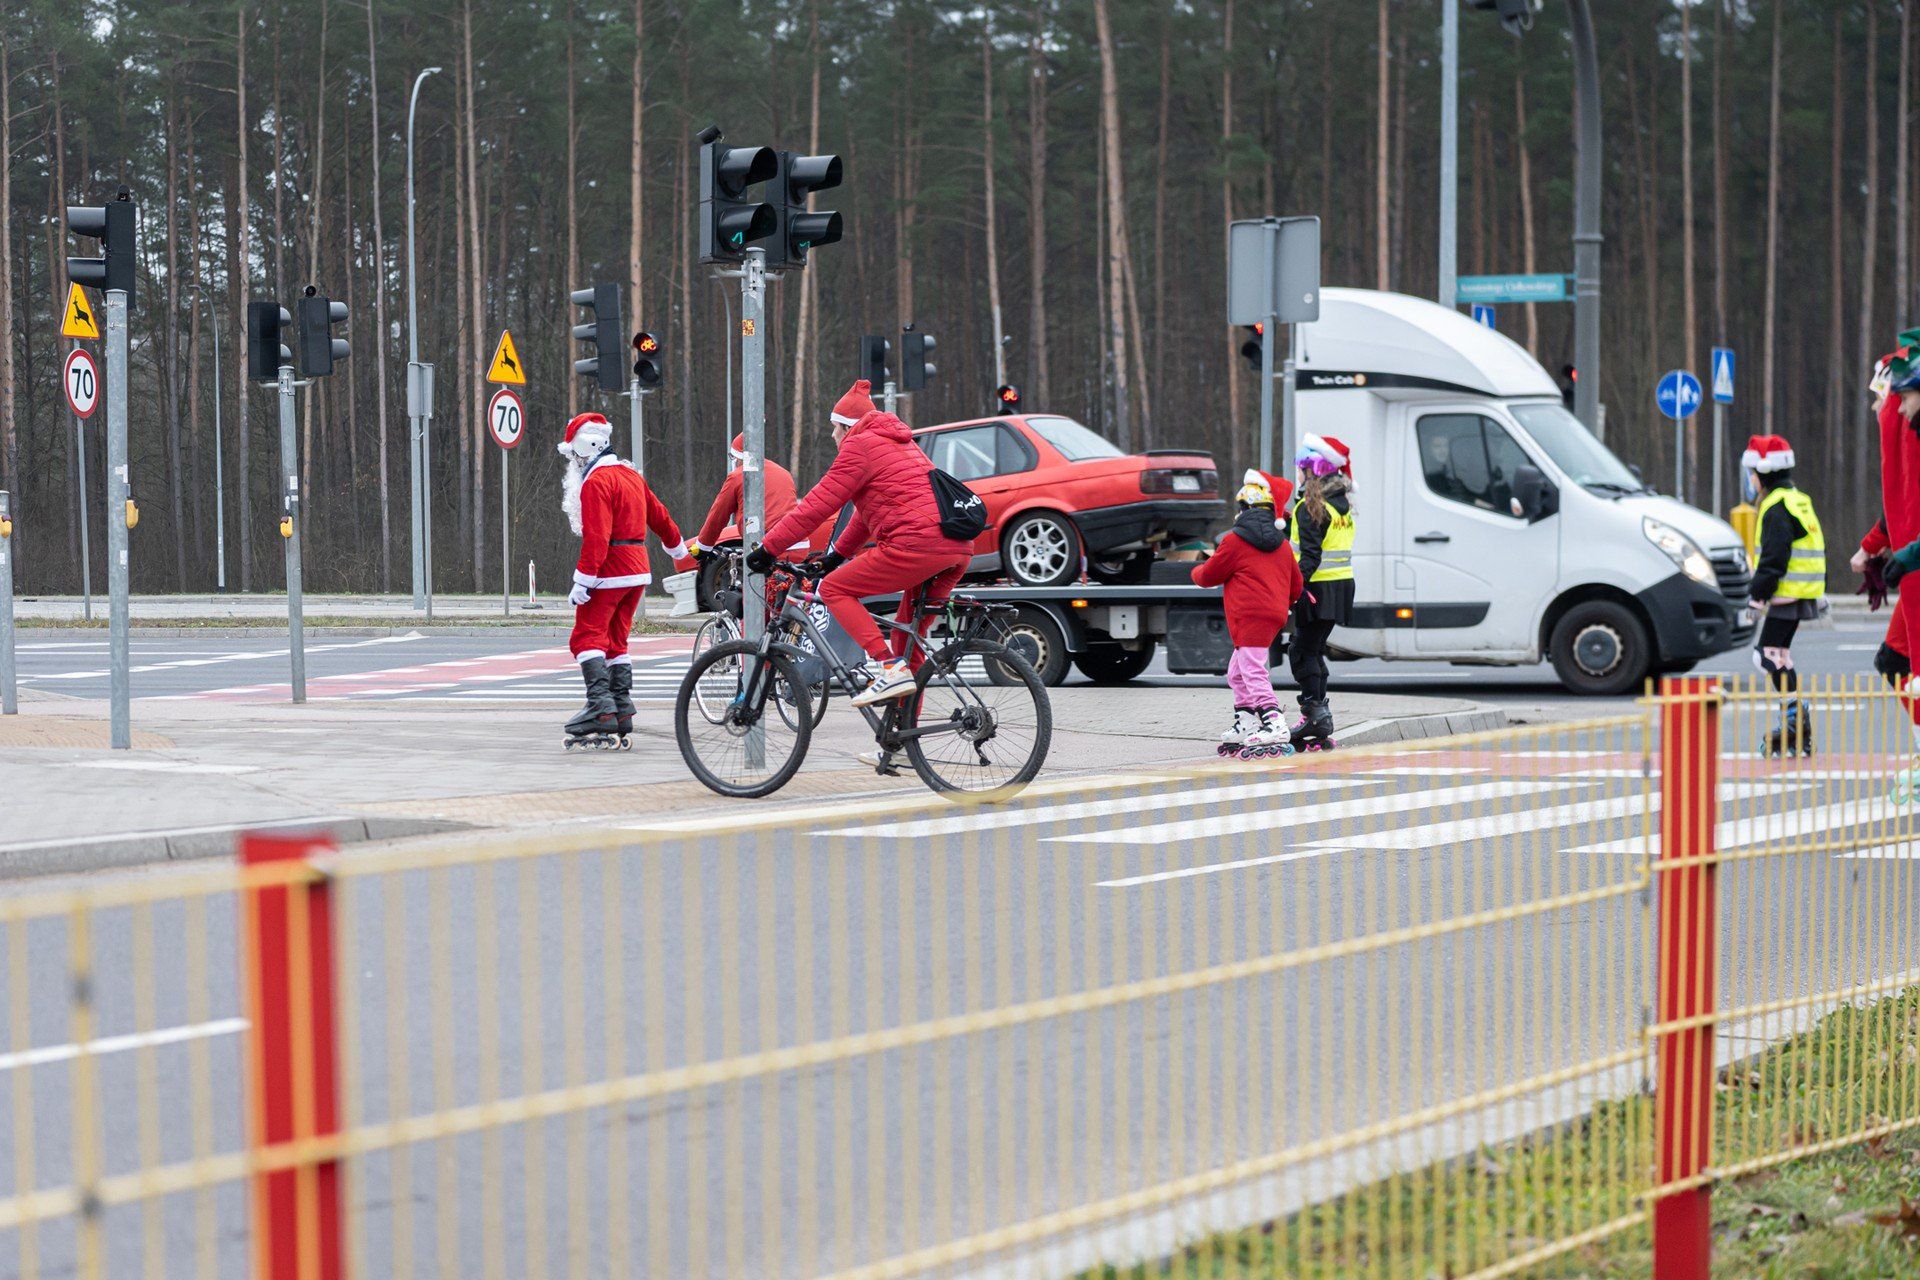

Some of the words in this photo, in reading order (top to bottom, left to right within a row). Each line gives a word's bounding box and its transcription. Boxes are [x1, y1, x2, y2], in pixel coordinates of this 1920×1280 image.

[72, 368, 94, 400] 70
[1311, 375, 1334, 386] Twin
[1334, 374, 1355, 386] Cab
[497, 405, 520, 434] 70
